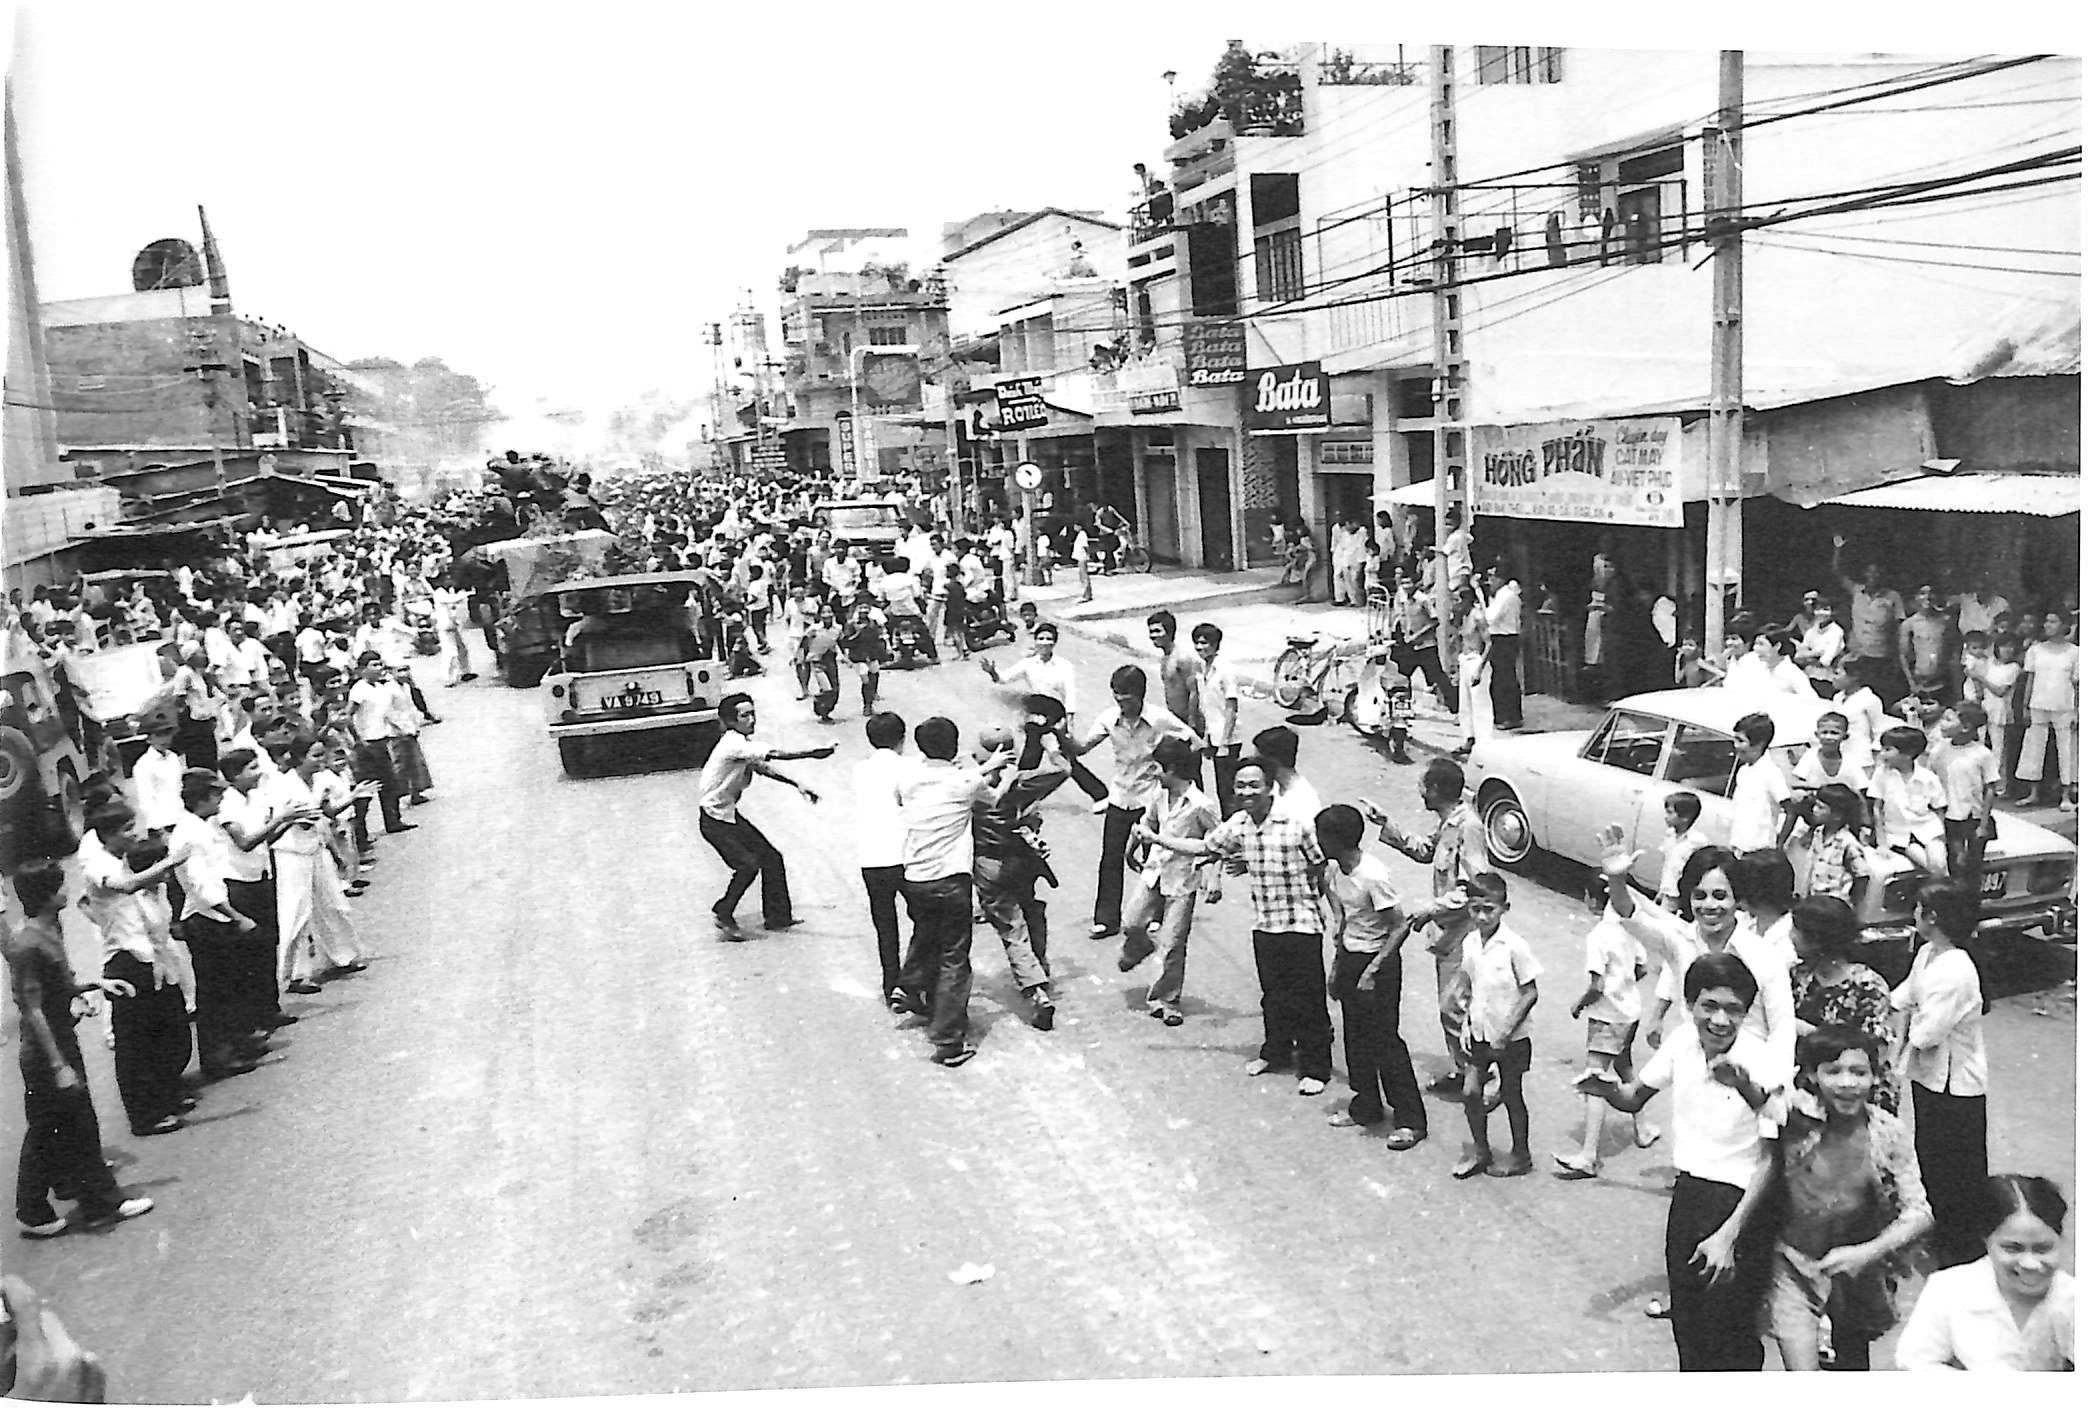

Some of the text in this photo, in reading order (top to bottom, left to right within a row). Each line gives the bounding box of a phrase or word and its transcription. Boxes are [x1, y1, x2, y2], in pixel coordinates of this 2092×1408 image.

[1190, 340, 1242, 354] Bata
[1191, 354, 1243, 369] Bata
[1190, 368, 1245, 384] Bata
[1254, 368, 1322, 412] Bata
[604, 696, 622, 708] VA
